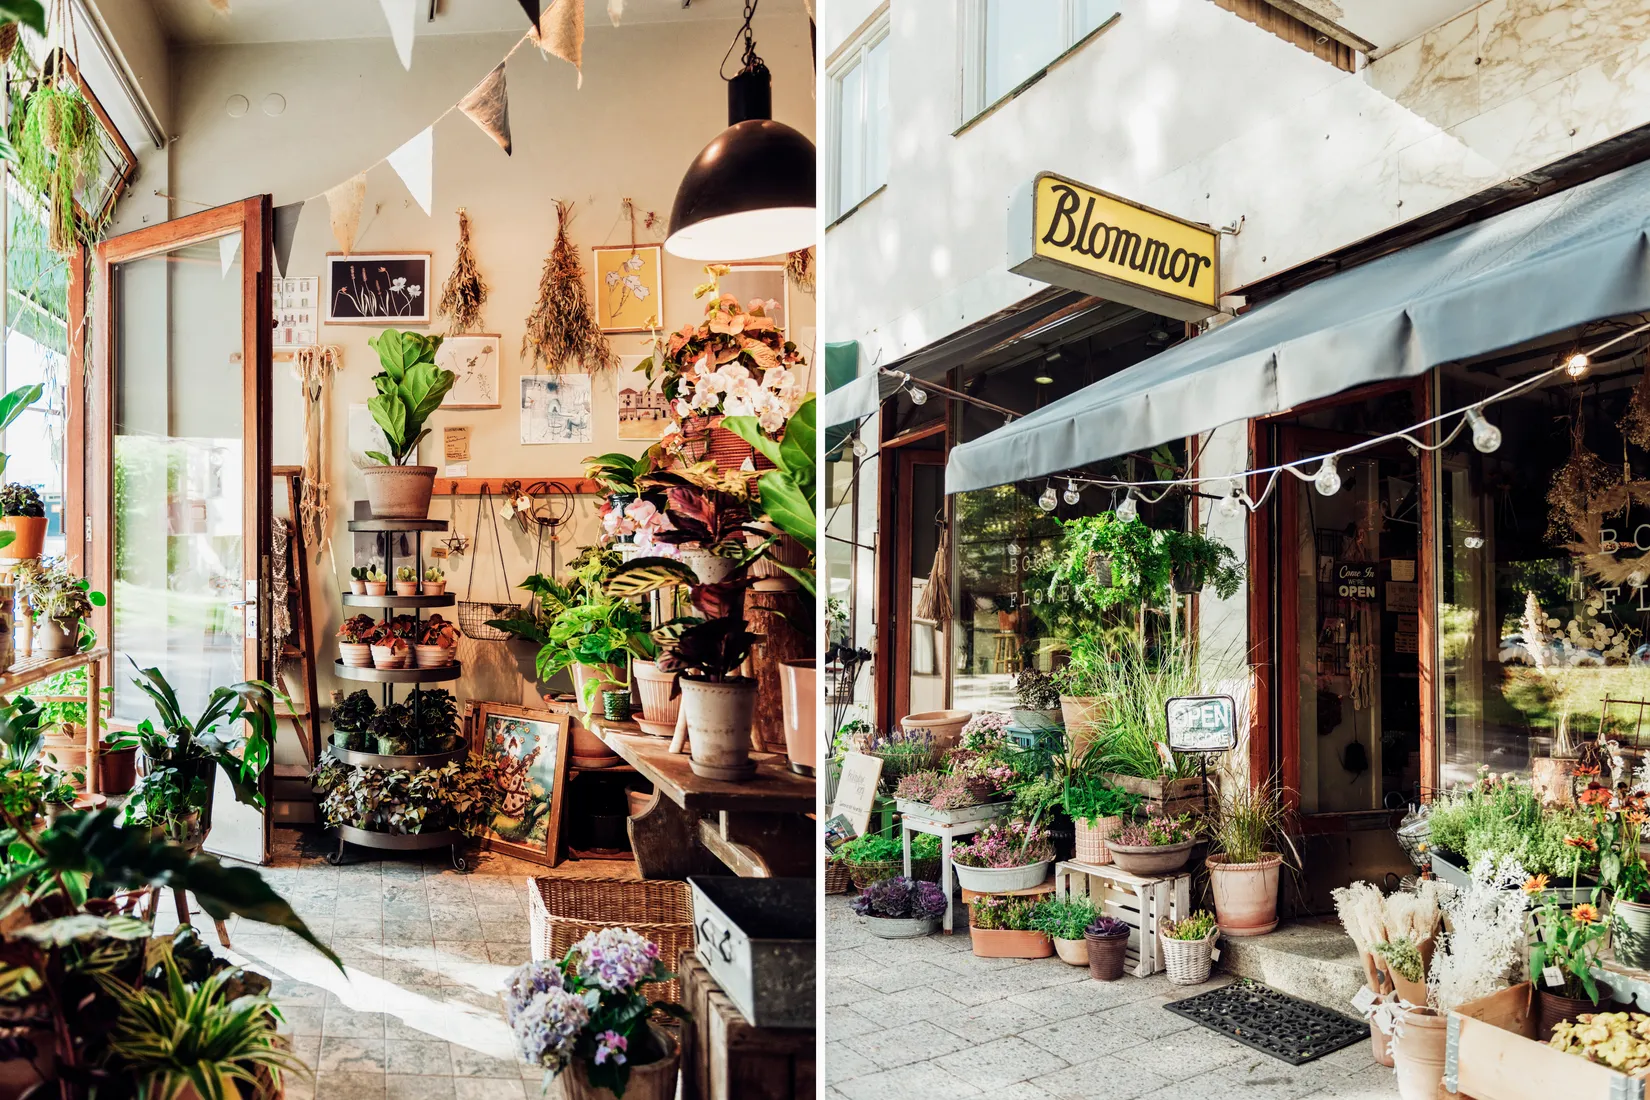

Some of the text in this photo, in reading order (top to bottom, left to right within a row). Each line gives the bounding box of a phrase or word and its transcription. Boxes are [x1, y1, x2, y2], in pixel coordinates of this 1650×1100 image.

[1042, 184, 1211, 288] Blommor
[1339, 565, 1375, 579] Come In
[1339, 585, 1375, 598] OPEN
[1171, 704, 1229, 728] OPEN
